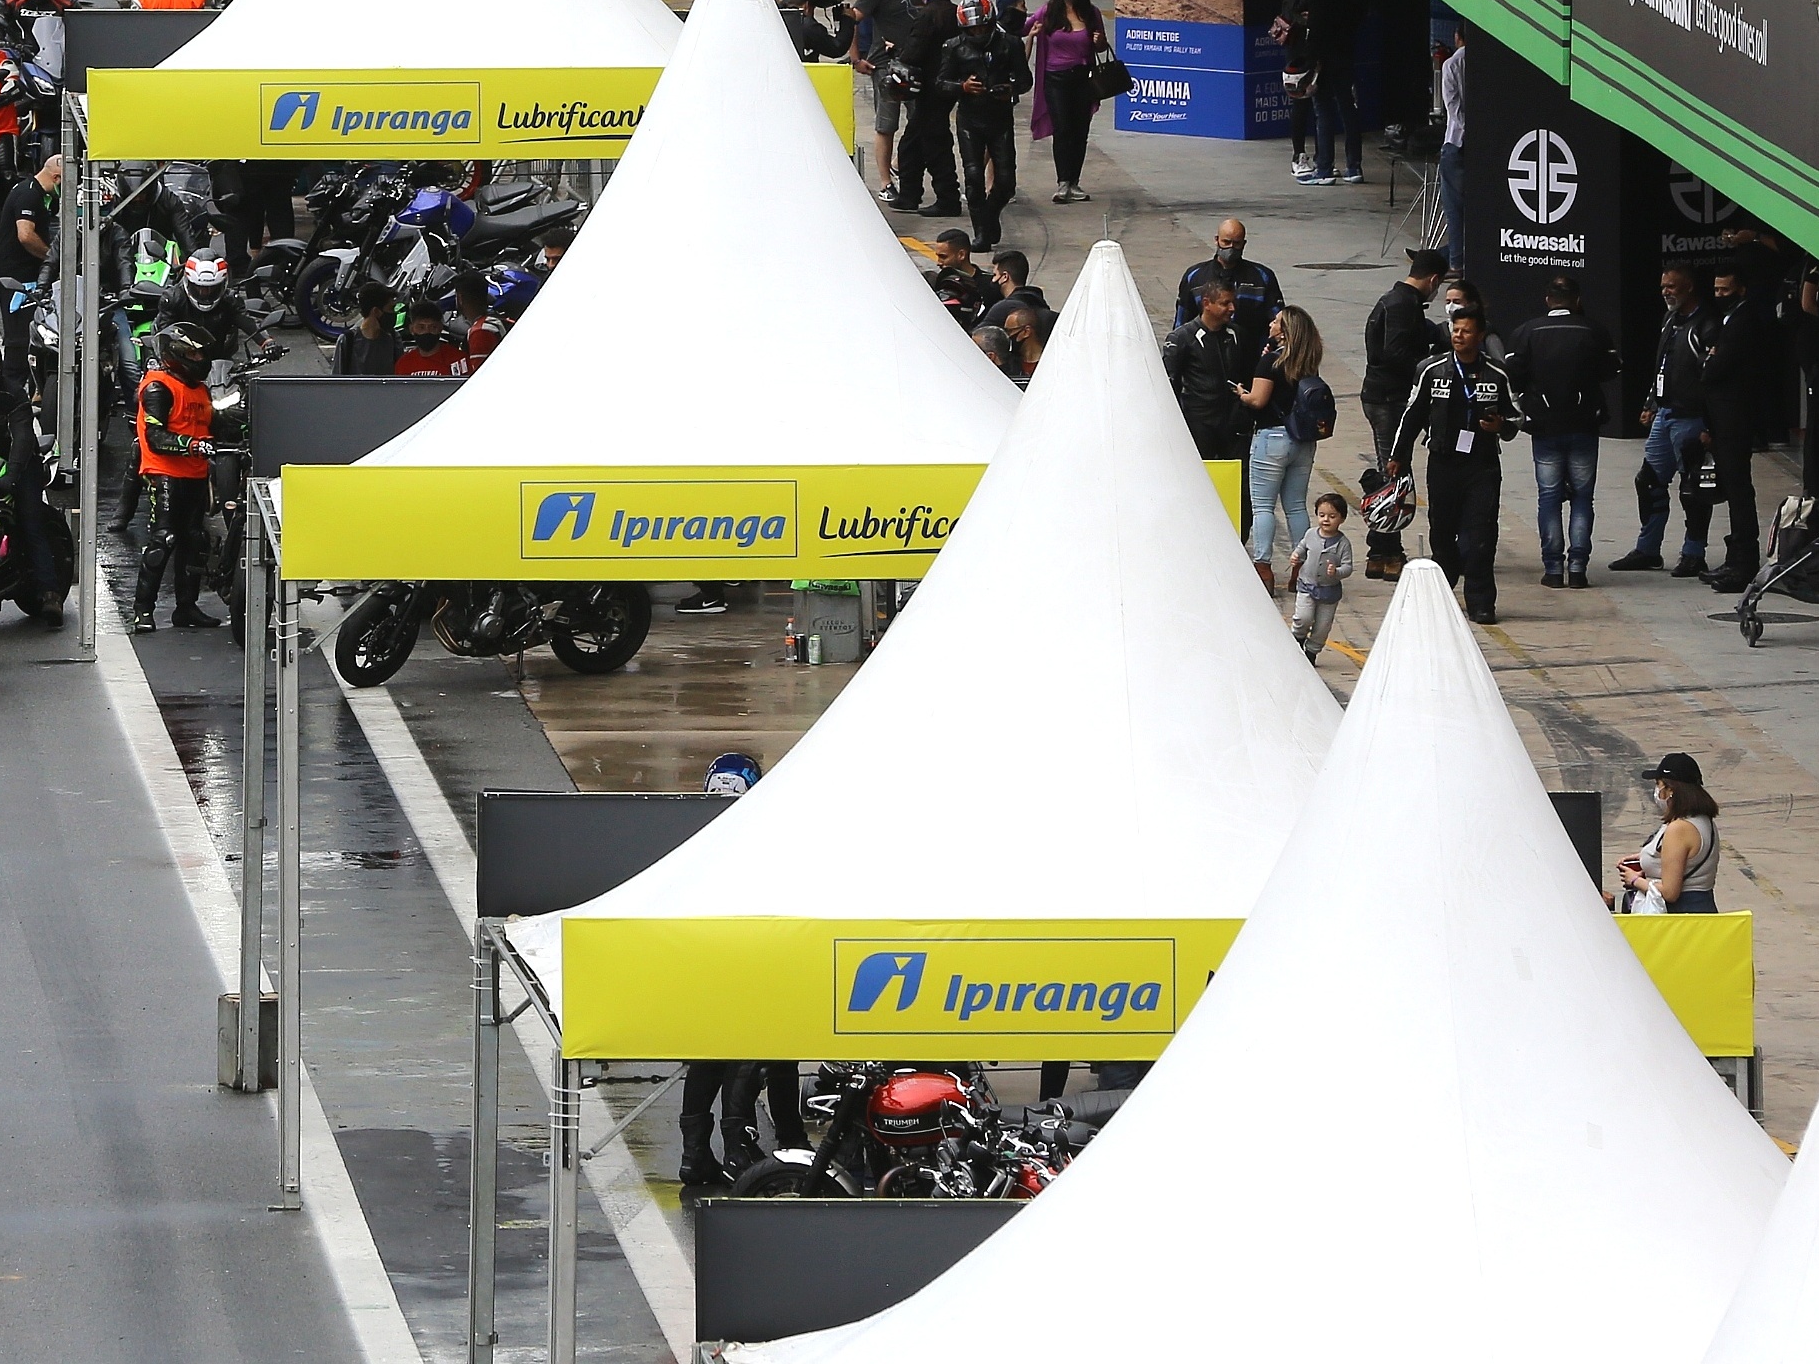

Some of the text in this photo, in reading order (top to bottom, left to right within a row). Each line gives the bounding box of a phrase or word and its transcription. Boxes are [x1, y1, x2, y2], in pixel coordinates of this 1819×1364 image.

[1126, 29, 1181, 42] ADRIEN METGE
[1255, 37, 1277, 47] ADRIE
[1718, 2, 1738, 54] good
[1737, 6, 1756, 63] times
[1755, 19, 1769, 67] roll
[1141, 79, 1191, 100] YAMAHA
[1130, 97, 1187, 106] RACING
[1255, 96, 1278, 109] MAIS
[331, 101, 645, 136] Ipiranga Lubrificant
[1255, 111, 1268, 123] DO
[1500, 228, 1585, 254] Kawasaki
[1500, 253, 1585, 269] Let the good times roll
[609, 509, 786, 547] Ipiranga
[943, 974, 1162, 1021] Ipiranga
[883, 1118, 920, 1126] TRIUMPH
